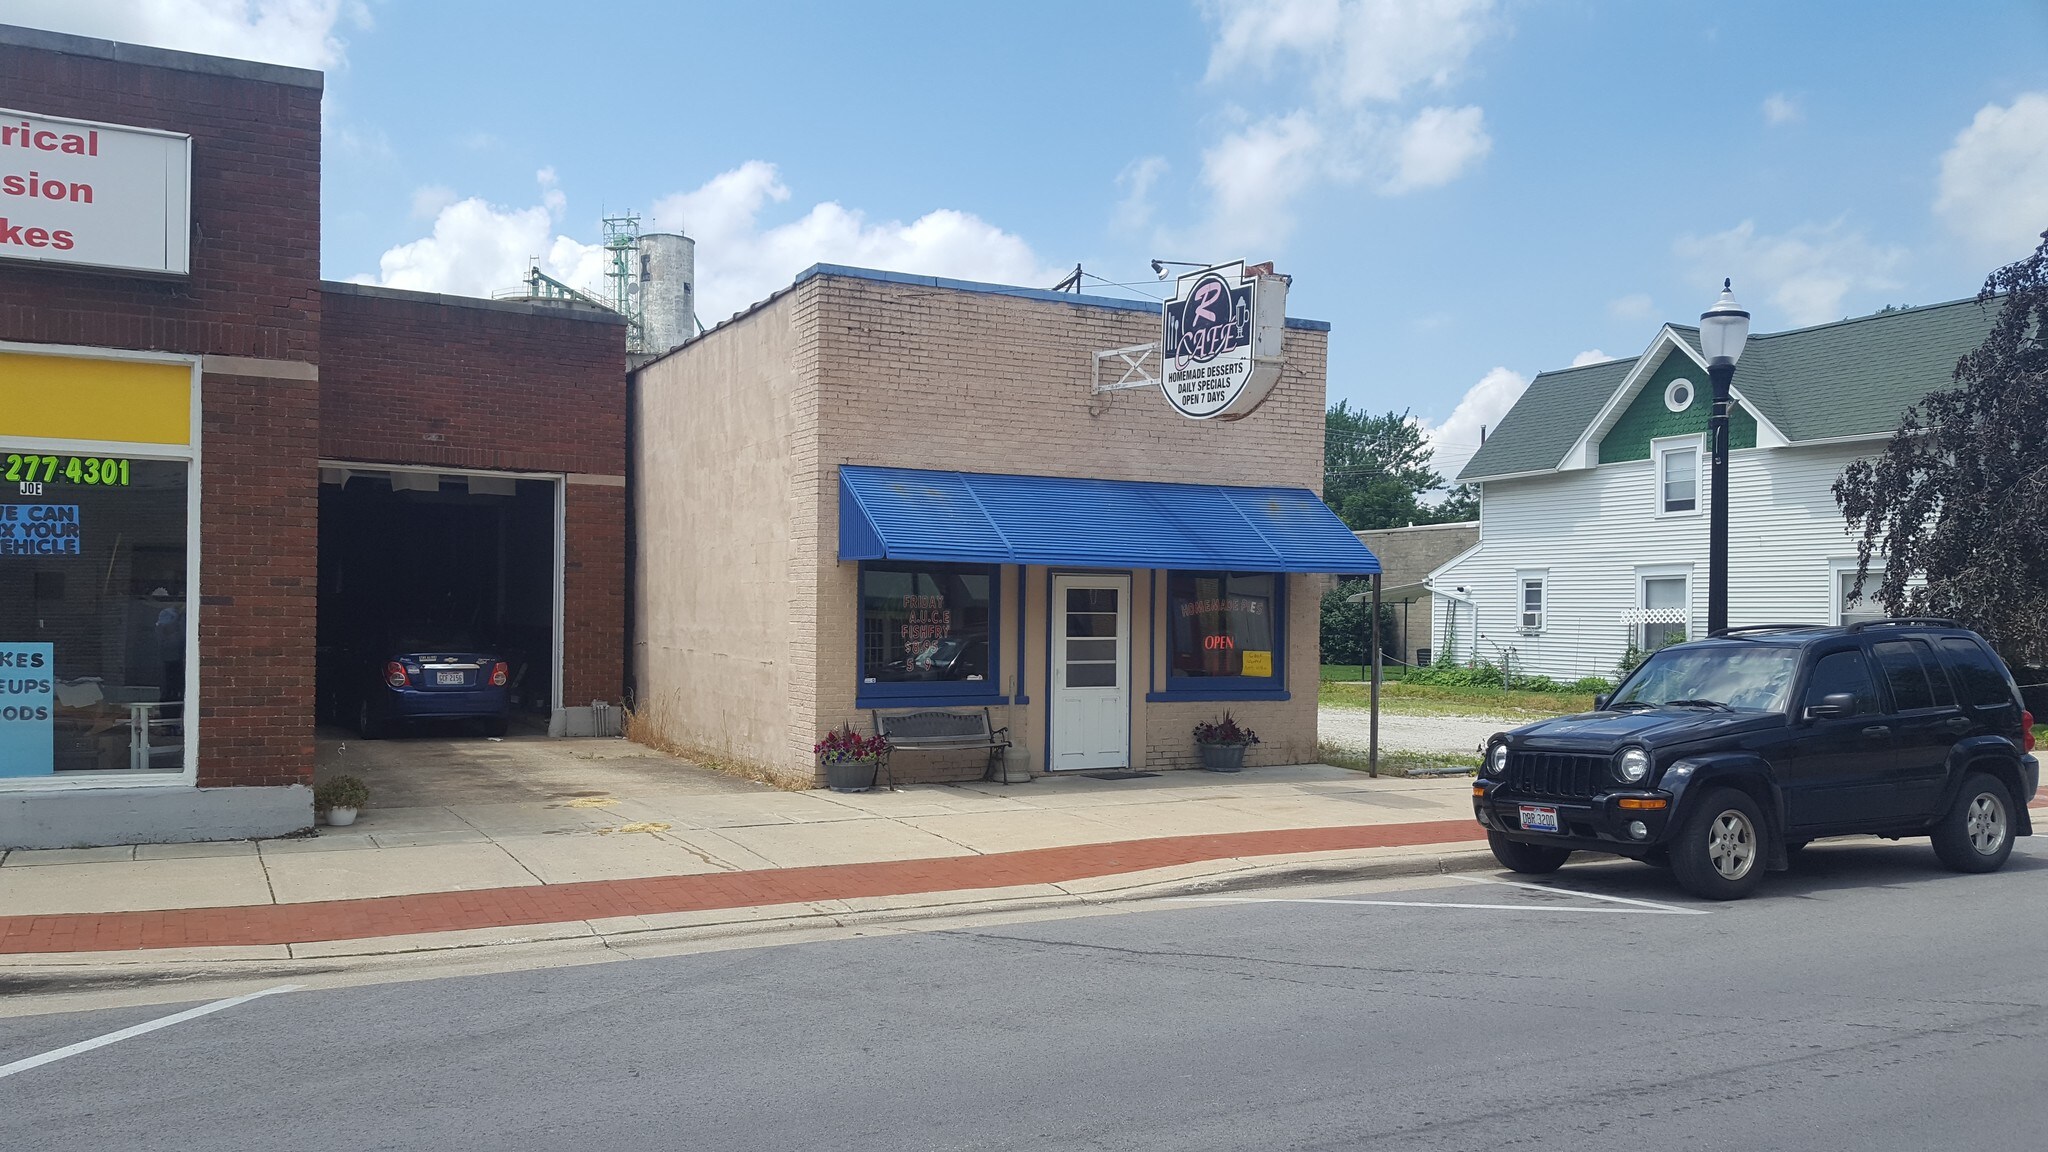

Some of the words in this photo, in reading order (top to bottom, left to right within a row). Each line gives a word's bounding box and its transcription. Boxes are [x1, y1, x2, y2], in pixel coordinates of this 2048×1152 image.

[2, 121, 98, 157] rical
[2, 171, 93, 204] sion
[0, 217, 74, 250] kes
[1192, 281, 1222, 327] R
[1168, 368, 1206, 383] HOMEMADE
[1206, 362, 1244, 379] DESSERTS
[1177, 381, 1197, 394] DAILY
[1197, 377, 1231, 392] SPECIALS
[1182, 394, 1199, 406] OPEN
[1201, 393, 1206, 404] 7
[1206, 391, 1225, 403] DAYS
[21, 482, 42, 495] JOE
[27, 506, 74, 522] CAN
[20, 522, 79, 539] YOUR
[0, 539, 76, 554] EHICLE
[903, 594, 944, 608] FRIDAY
[1204, 635, 1235, 650] OPEN
[0, 651, 44, 668] KES
[0, 706, 48, 721] ODS
